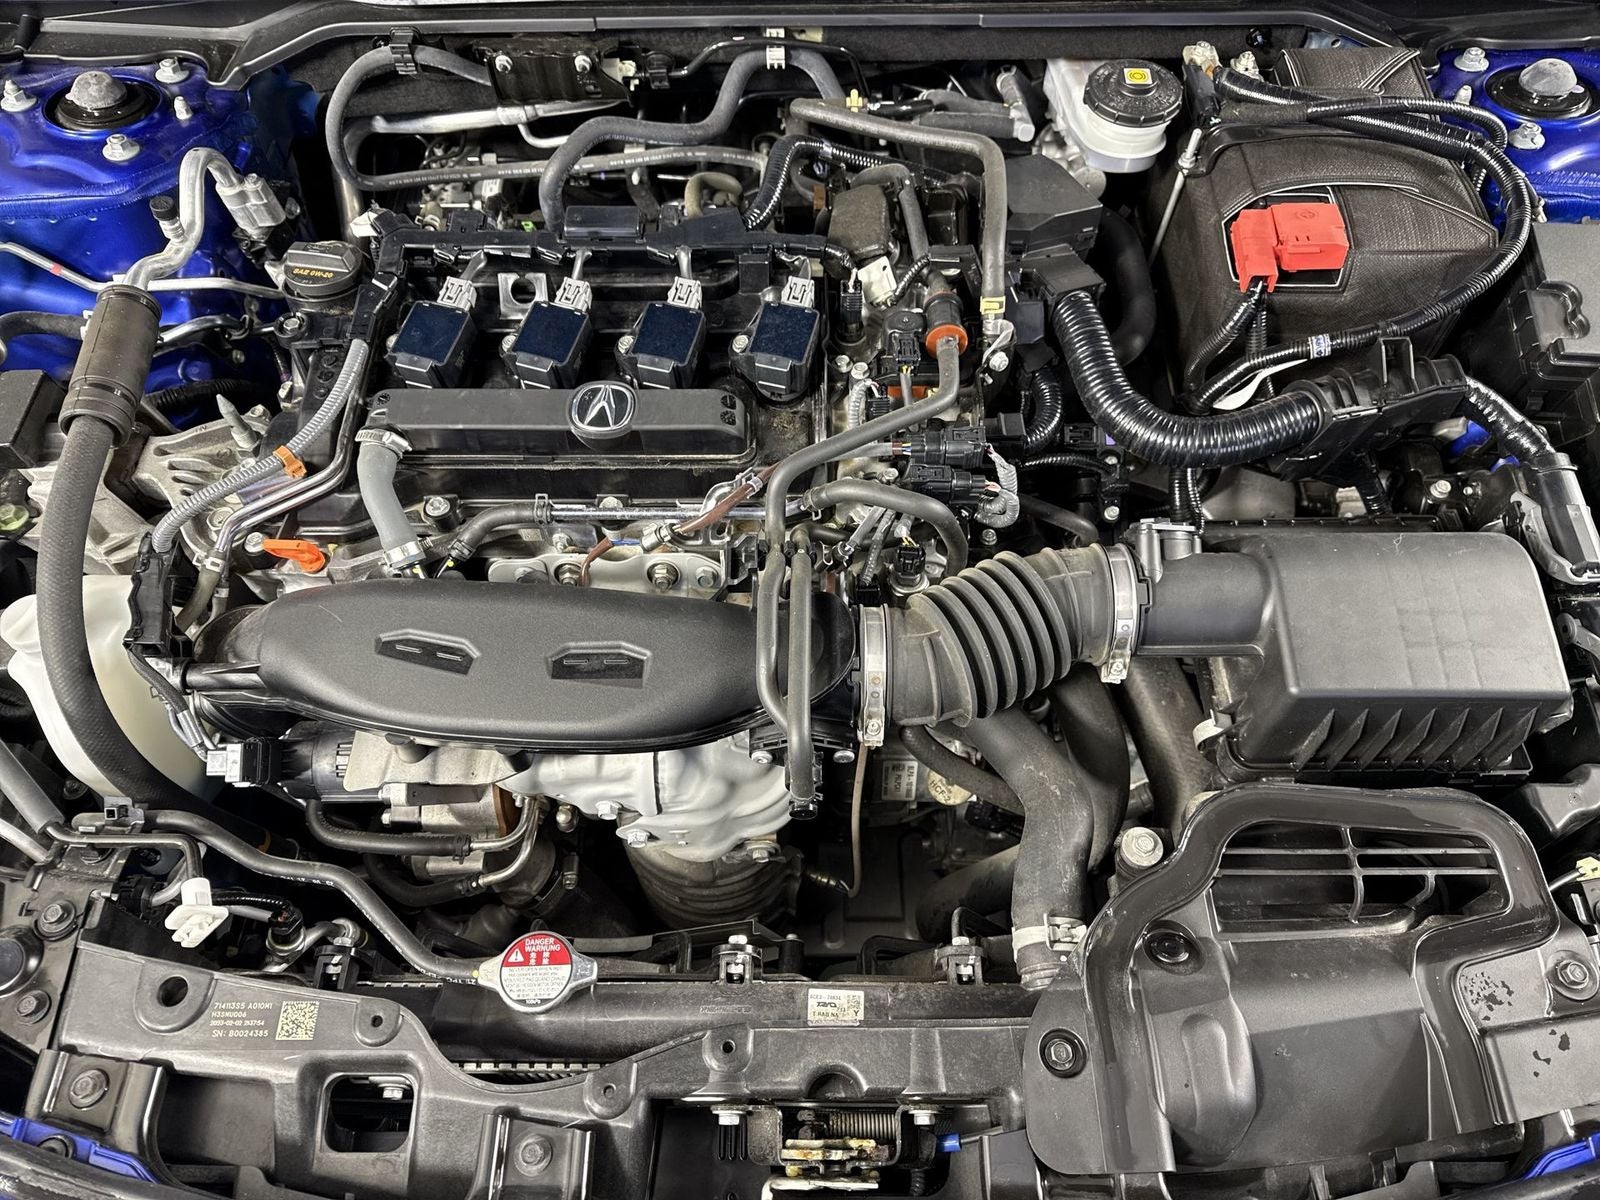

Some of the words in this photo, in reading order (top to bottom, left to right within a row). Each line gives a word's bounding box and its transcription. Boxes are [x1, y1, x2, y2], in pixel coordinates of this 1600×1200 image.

[310, 270, 334, 278] 0W-20
[929, 780, 951, 803] HCF-2
[525, 944, 560, 952] WARNUNG
[212, 1030, 226, 1038] SN:
